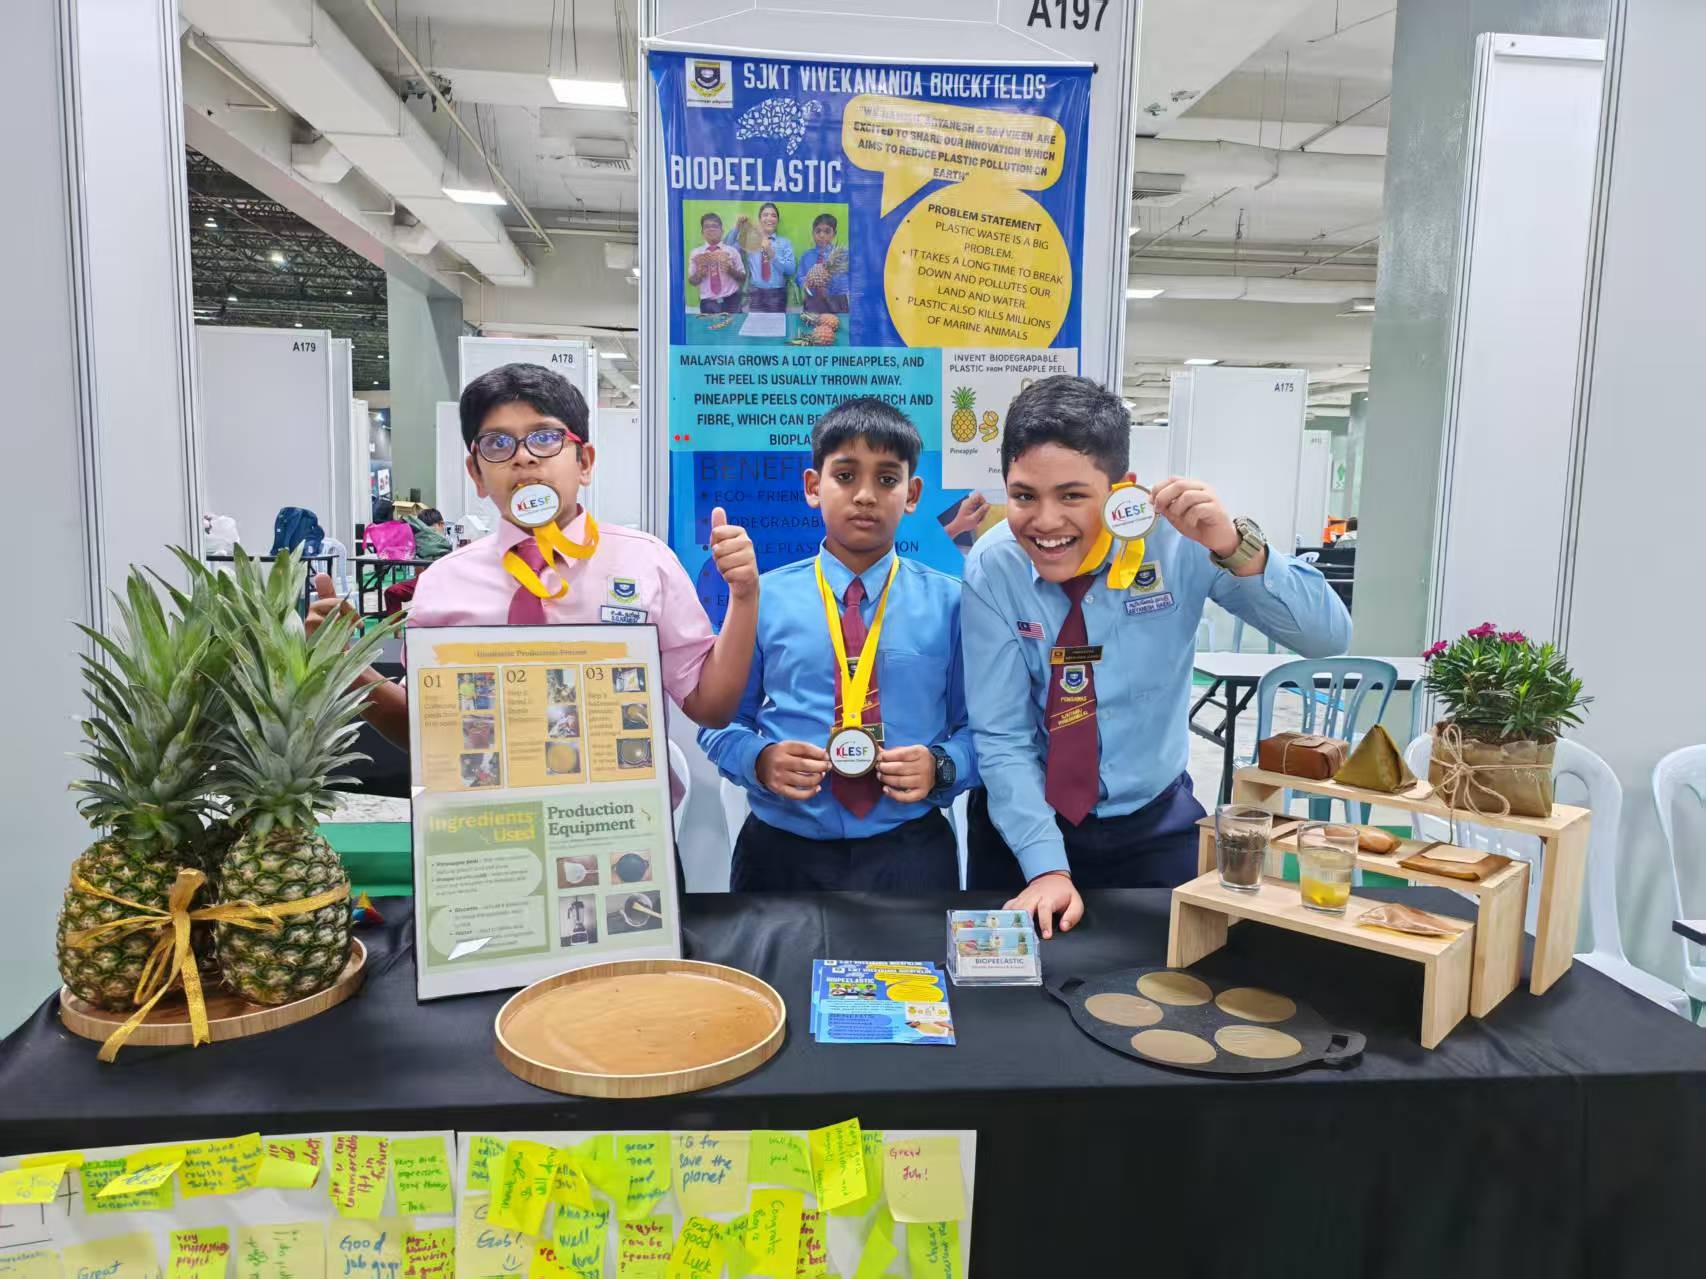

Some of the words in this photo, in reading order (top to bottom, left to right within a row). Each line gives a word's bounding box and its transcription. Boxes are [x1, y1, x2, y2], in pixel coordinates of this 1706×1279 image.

[1027, 0, 1109, 31] A197
[743, 62, 791, 90] SJKT
[800, 65, 923, 95] VIVEKANANDA
[930, 72, 1047, 99] BRICKFIELDS
[896, 130, 908, 139] TO
[910, 131, 942, 145] SHARE
[944, 136, 963, 148] OUR
[964, 140, 1021, 156] INNOVATION
[1024, 149, 1055, 160] WHICH
[858, 138, 883, 150] AIMS
[886, 143, 897, 153] TO
[899, 146, 936, 159] REDUCE
[938, 152, 978, 167] PLASTIC
[980, 159, 1033, 174] POLLUTION
[1035, 166, 1047, 176] ON
[671, 155, 842, 193] BIOPEELASTIC
[927, 203, 979, 222] PROBLEM
[980, 211, 1042, 233] STATEMENT
[935, 221, 975, 237] PLASTIC
[977, 229, 1010, 244] WASTE
[1013, 235, 1021, 244] IS
[1023, 238, 1031, 246] A
[1033, 239, 1049, 250] BIG
[964, 242, 1014, 259] PROBLEM.
[910, 248, 919, 257] IT
[920, 250, 950, 265] TAKES
[952, 256, 960, 266] A
[962, 259, 991, 271] LONG
[993, 264, 1015, 276] TIME
[1019, 267, 1031, 278] TO
[1033, 270, 1063, 285] BREAK
[918, 266, 951, 280] DOWN
[953, 272, 976, 285] AND
[978, 277, 1028, 293] POLLUTES
[1029, 286, 1051, 298] OUR
[937, 285, 966, 298] LAND
[968, 290, 991, 302] AND
[907, 296, 947, 311] PLASTIC
[950, 303, 976, 316] ALSO
[978, 307, 1008, 321] KILLS
[1005, 312, 1051, 329] MILLIONS
[927, 315, 941, 325] OF
[943, 318, 981, 332] MARINE
[983, 325, 1028, 340] ANIMALS
[293, 341, 316, 352] A179
[551, 353, 573, 364] A178
[680, 354, 736, 366] MALAYSIA
[738, 355, 779, 366] GROWS
[782, 355, 789, 366] A
[792, 355, 811, 366] LOT
[815, 355, 828, 366] OF
[831, 356, 900, 368] PINEAPPLES,
[902, 356, 924, 367] AND
[954, 354, 986, 362] INVENT
[989, 354, 1058, 363] BIODEGRADABLE
[949, 364, 984, 373] PLASTIC
[1005, 364, 1046, 373] PINEAPPLE
[1048, 364, 1067, 373] PEEL
[704, 374, 726, 385] THE
[729, 374, 755, 385] PEEL
[758, 374, 768, 385] IS
[771, 374, 818, 386] USUALLY
[821, 374, 868, 386] THROWN
[870, 375, 902, 386] AWAY.
[1274, 382, 1294, 392] A175
[694, 393, 758, 405] PINEAPPLE
[761, 393, 797, 405] PEELS
[909, 394, 934, 405] AND
[697, 413, 735, 427] FIBRE,
[737, 414, 777, 425] WHICH
[780, 414, 804, 425] CAN
[949, 447, 978, 455] Pineapple
[517, 495, 551, 511] KLESF
[1111, 502, 1147, 521] KLESF
[423, 675, 442, 688] 01
[506, 670, 527, 683] 02
[586, 667, 604, 681] 03
[836, 746, 868, 757] KLESF
[547, 803, 635, 819] Production
[430, 811, 534, 833] Ingredients
[548, 818, 635, 837] Equipment
[494, 827, 535, 842] Used
[683, 1169, 726, 1192] planet
